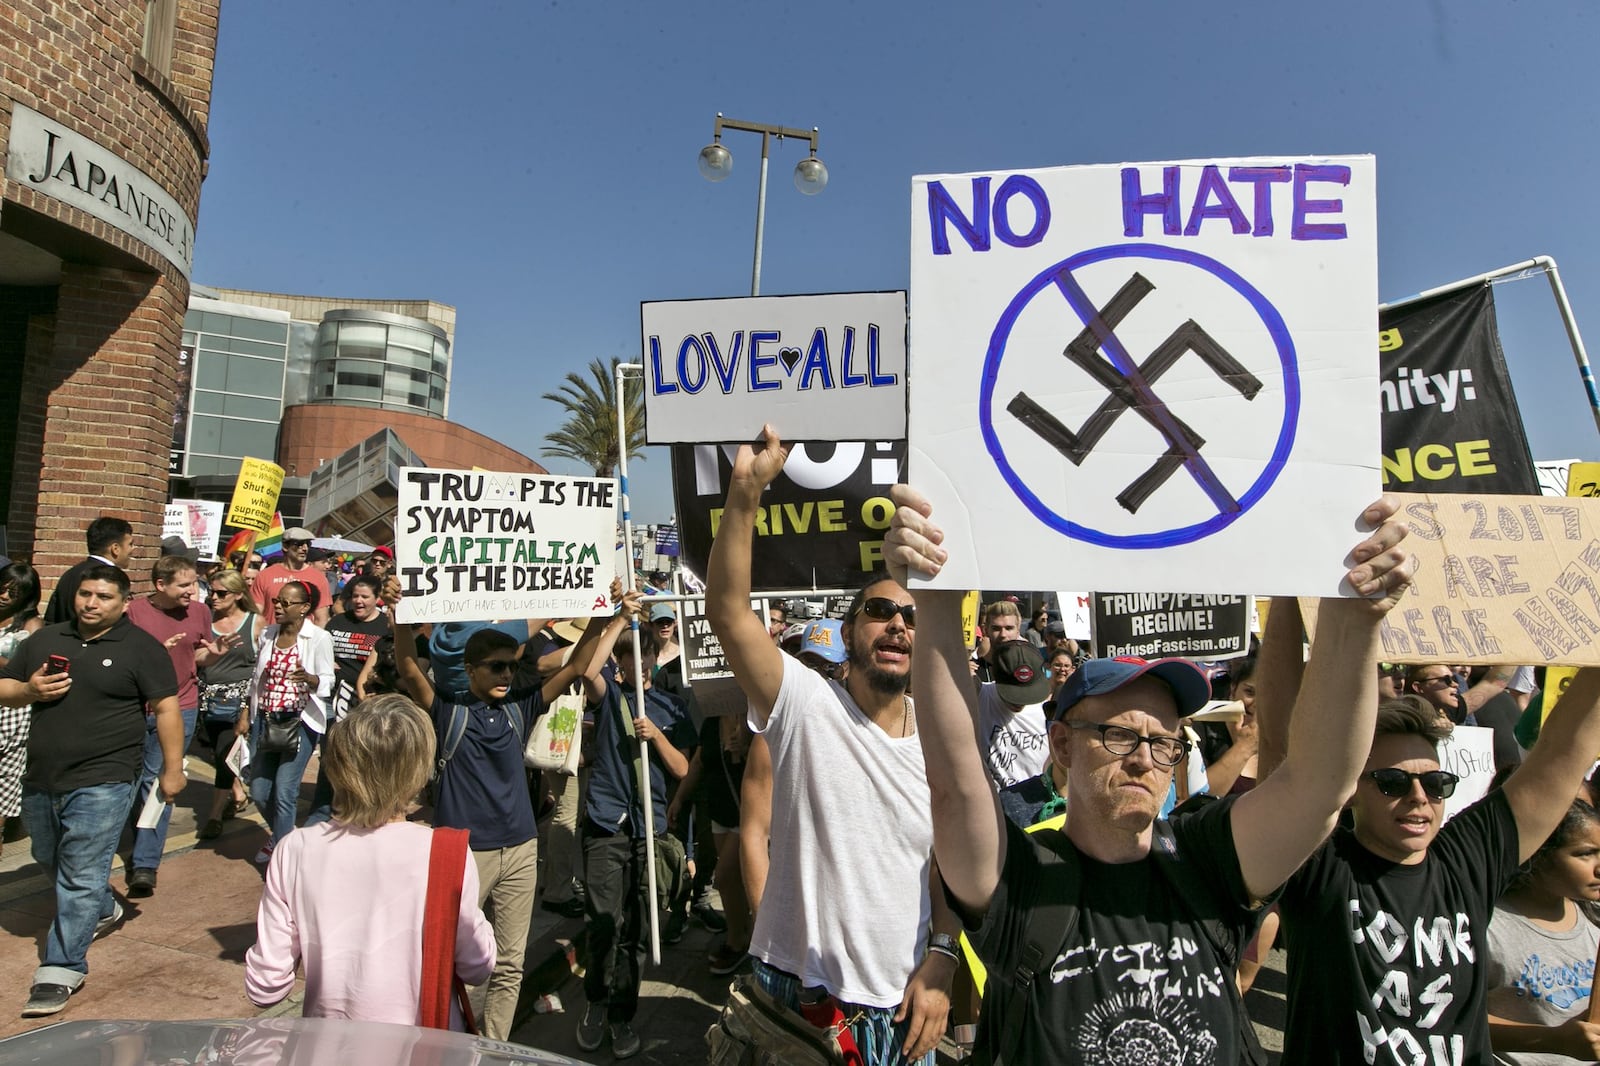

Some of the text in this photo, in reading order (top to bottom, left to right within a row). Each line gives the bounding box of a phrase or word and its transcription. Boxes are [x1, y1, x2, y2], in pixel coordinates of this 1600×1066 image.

[29, 128, 176, 246] JAPANESE
[928, 164, 1351, 255] NO HATE
[649, 322, 898, 397] LOVE ALL
[243, 480, 264, 494] Shut
[539, 480, 567, 506] IS
[573, 481, 614, 508] THE
[407, 506, 535, 534] SYMPTOM
[1461, 499, 1582, 541] 2017
[418, 535, 601, 565] CAPITALISM
[401, 566, 594, 597] IS THE DISEASE
[1443, 553, 1531, 599] ARE
[412, 600, 438, 617] WE
[475, 600, 496, 611] HAVE
[1101, 592, 1242, 616] TRUMP/PENCE
[688, 619, 713, 638] ¡YA
[807, 624, 833, 647] LA
[1131, 610, 1214, 637] REGIME!
[698, 647, 709, 657] AL
[1106, 636, 1240, 658] RefuseFascism.org
[689, 657, 718, 669] TRUMP
[719, 656, 725, 667] Y
[1371, 969, 1454, 1030] AS
